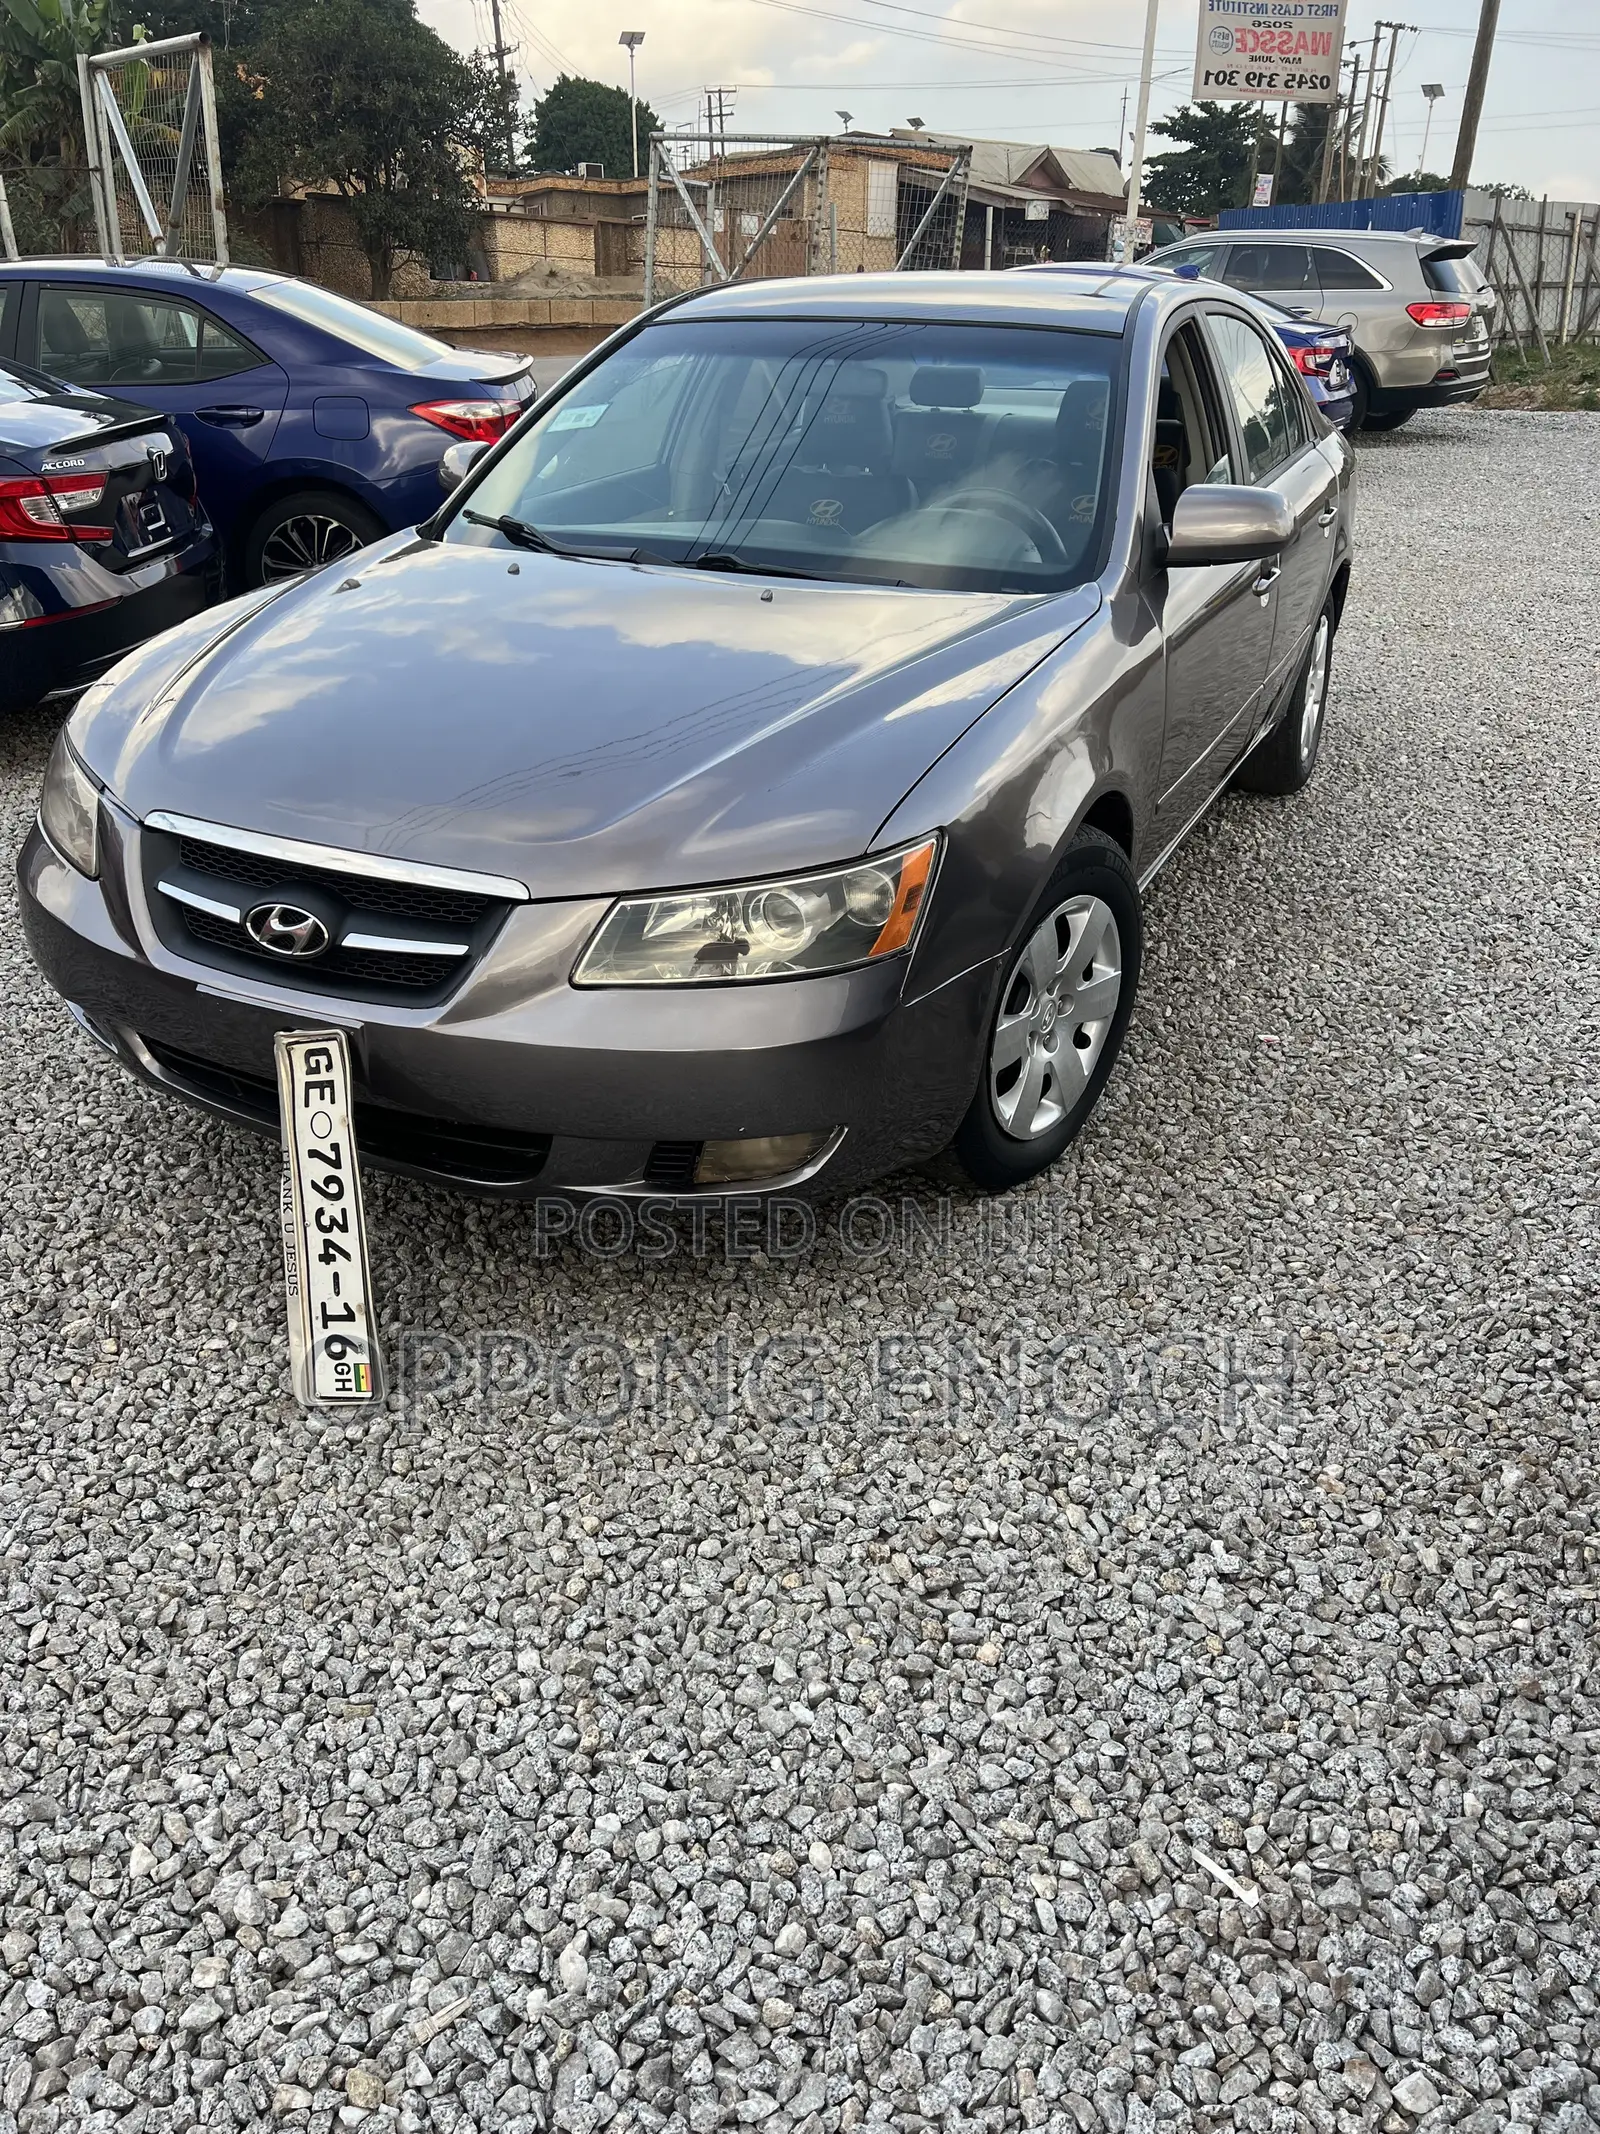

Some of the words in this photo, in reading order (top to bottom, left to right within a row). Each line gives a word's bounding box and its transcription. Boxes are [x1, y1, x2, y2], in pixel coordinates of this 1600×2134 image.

[41, 458, 86, 472] ACCORD
[302, 1046, 337, 1109] GE
[281, 1146, 294, 1214] THANK
[284, 1222, 294, 1234] U
[307, 1142, 358, 1361] 7934-16
[285, 1241, 299, 1297] JESUS
[333, 1361, 353, 1392] GH
